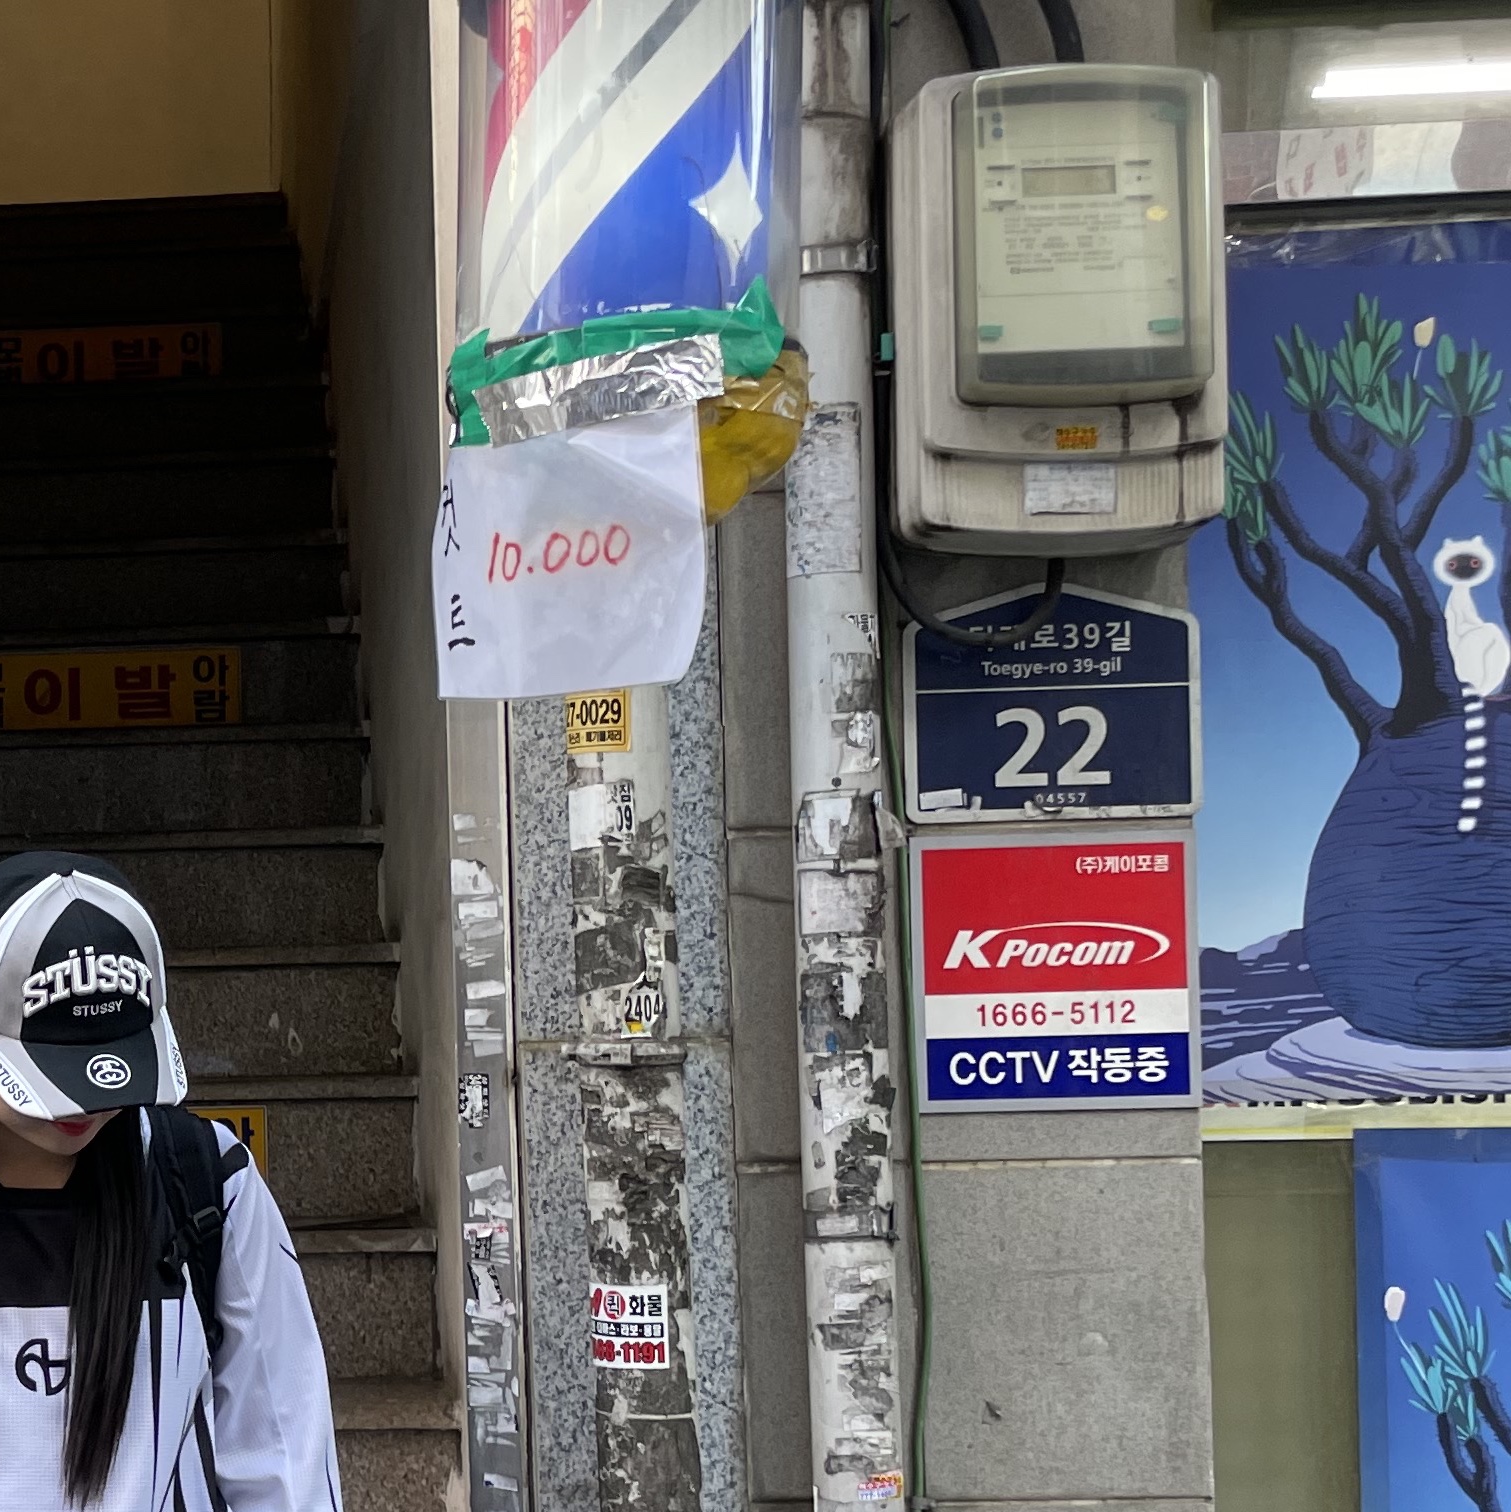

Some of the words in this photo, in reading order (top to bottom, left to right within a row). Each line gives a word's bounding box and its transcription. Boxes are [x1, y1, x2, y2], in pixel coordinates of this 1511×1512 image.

[488, 524, 631, 584] 10.000
[981, 660, 1068, 679] Toegye-ro
[1073, 656, 1122, 676] 39-gil
[24, 663, 177, 721] 이발
[995, 705, 1112, 788] 22
[1075, 855, 1169, 874] (주)케이포콤
[22, 946, 153, 1018] STÜSSY
[73, 1000, 123, 1017] STUSSY
[977, 1000, 1136, 1028] 1666-5112
[949, 1050, 1059, 1086] CCTV
[1067, 1047, 1170, 1084] 작동중
[628, 1294, 663, 1317] 화물
